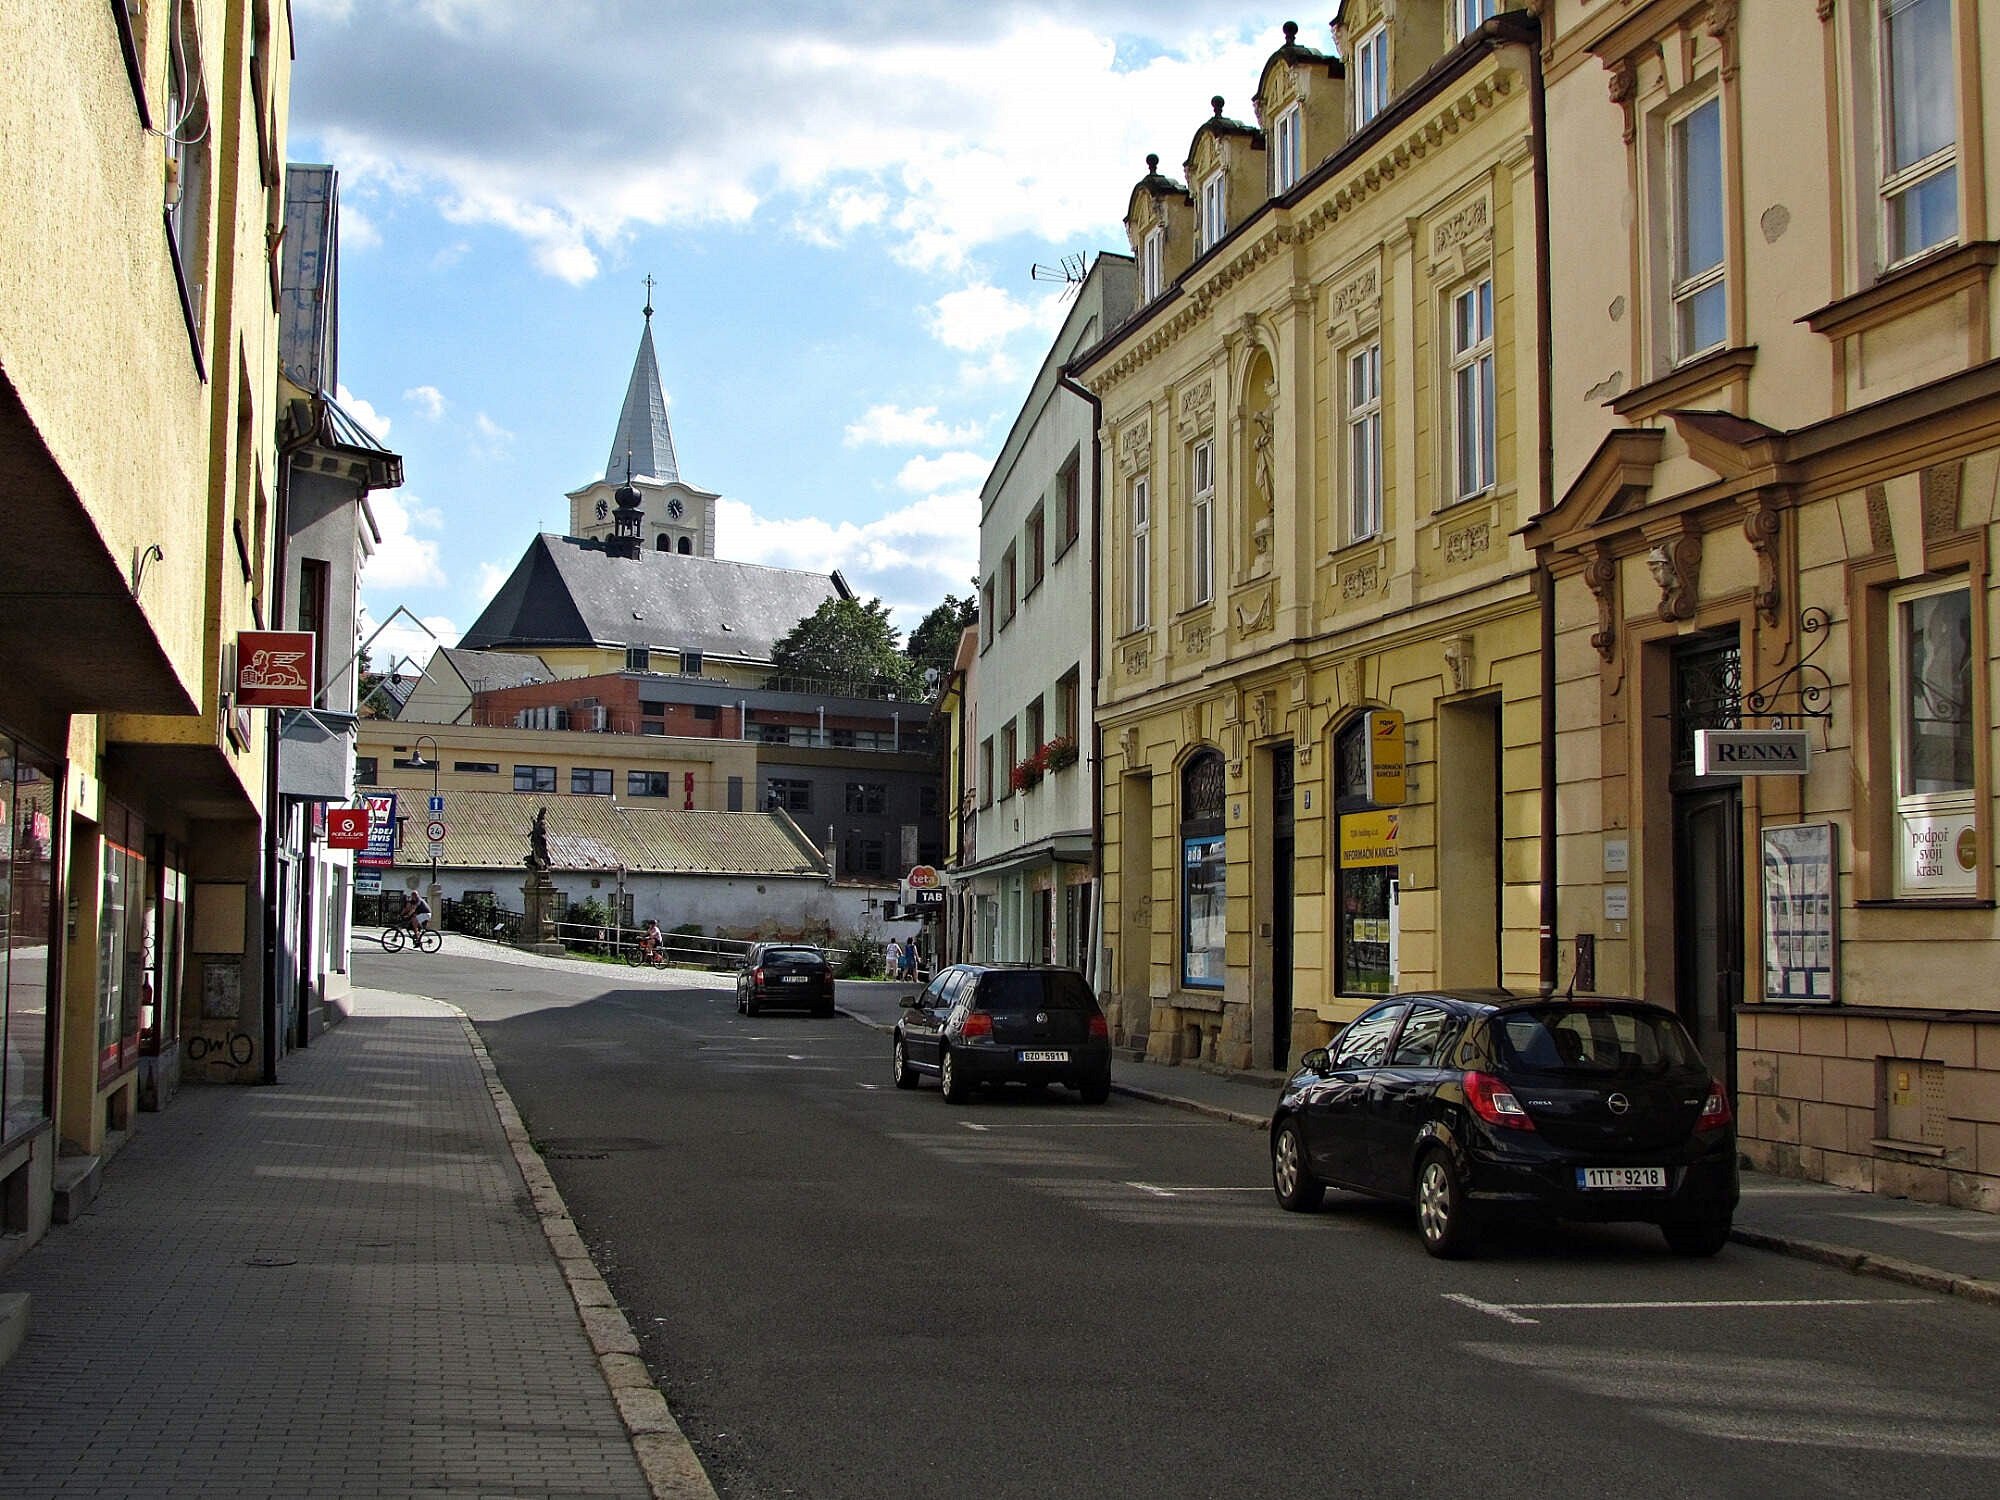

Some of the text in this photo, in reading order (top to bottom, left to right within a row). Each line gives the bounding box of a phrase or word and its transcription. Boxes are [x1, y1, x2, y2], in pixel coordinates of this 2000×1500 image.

[1716, 743, 1797, 762] RENNA
[1912, 827, 1949, 848] podpoř
[1920, 844, 1942, 861] svoji
[1916, 861, 1943, 876] krásu
[922, 892, 943, 902] TAB
[1589, 1169, 1658, 1186] 1TT 9218
